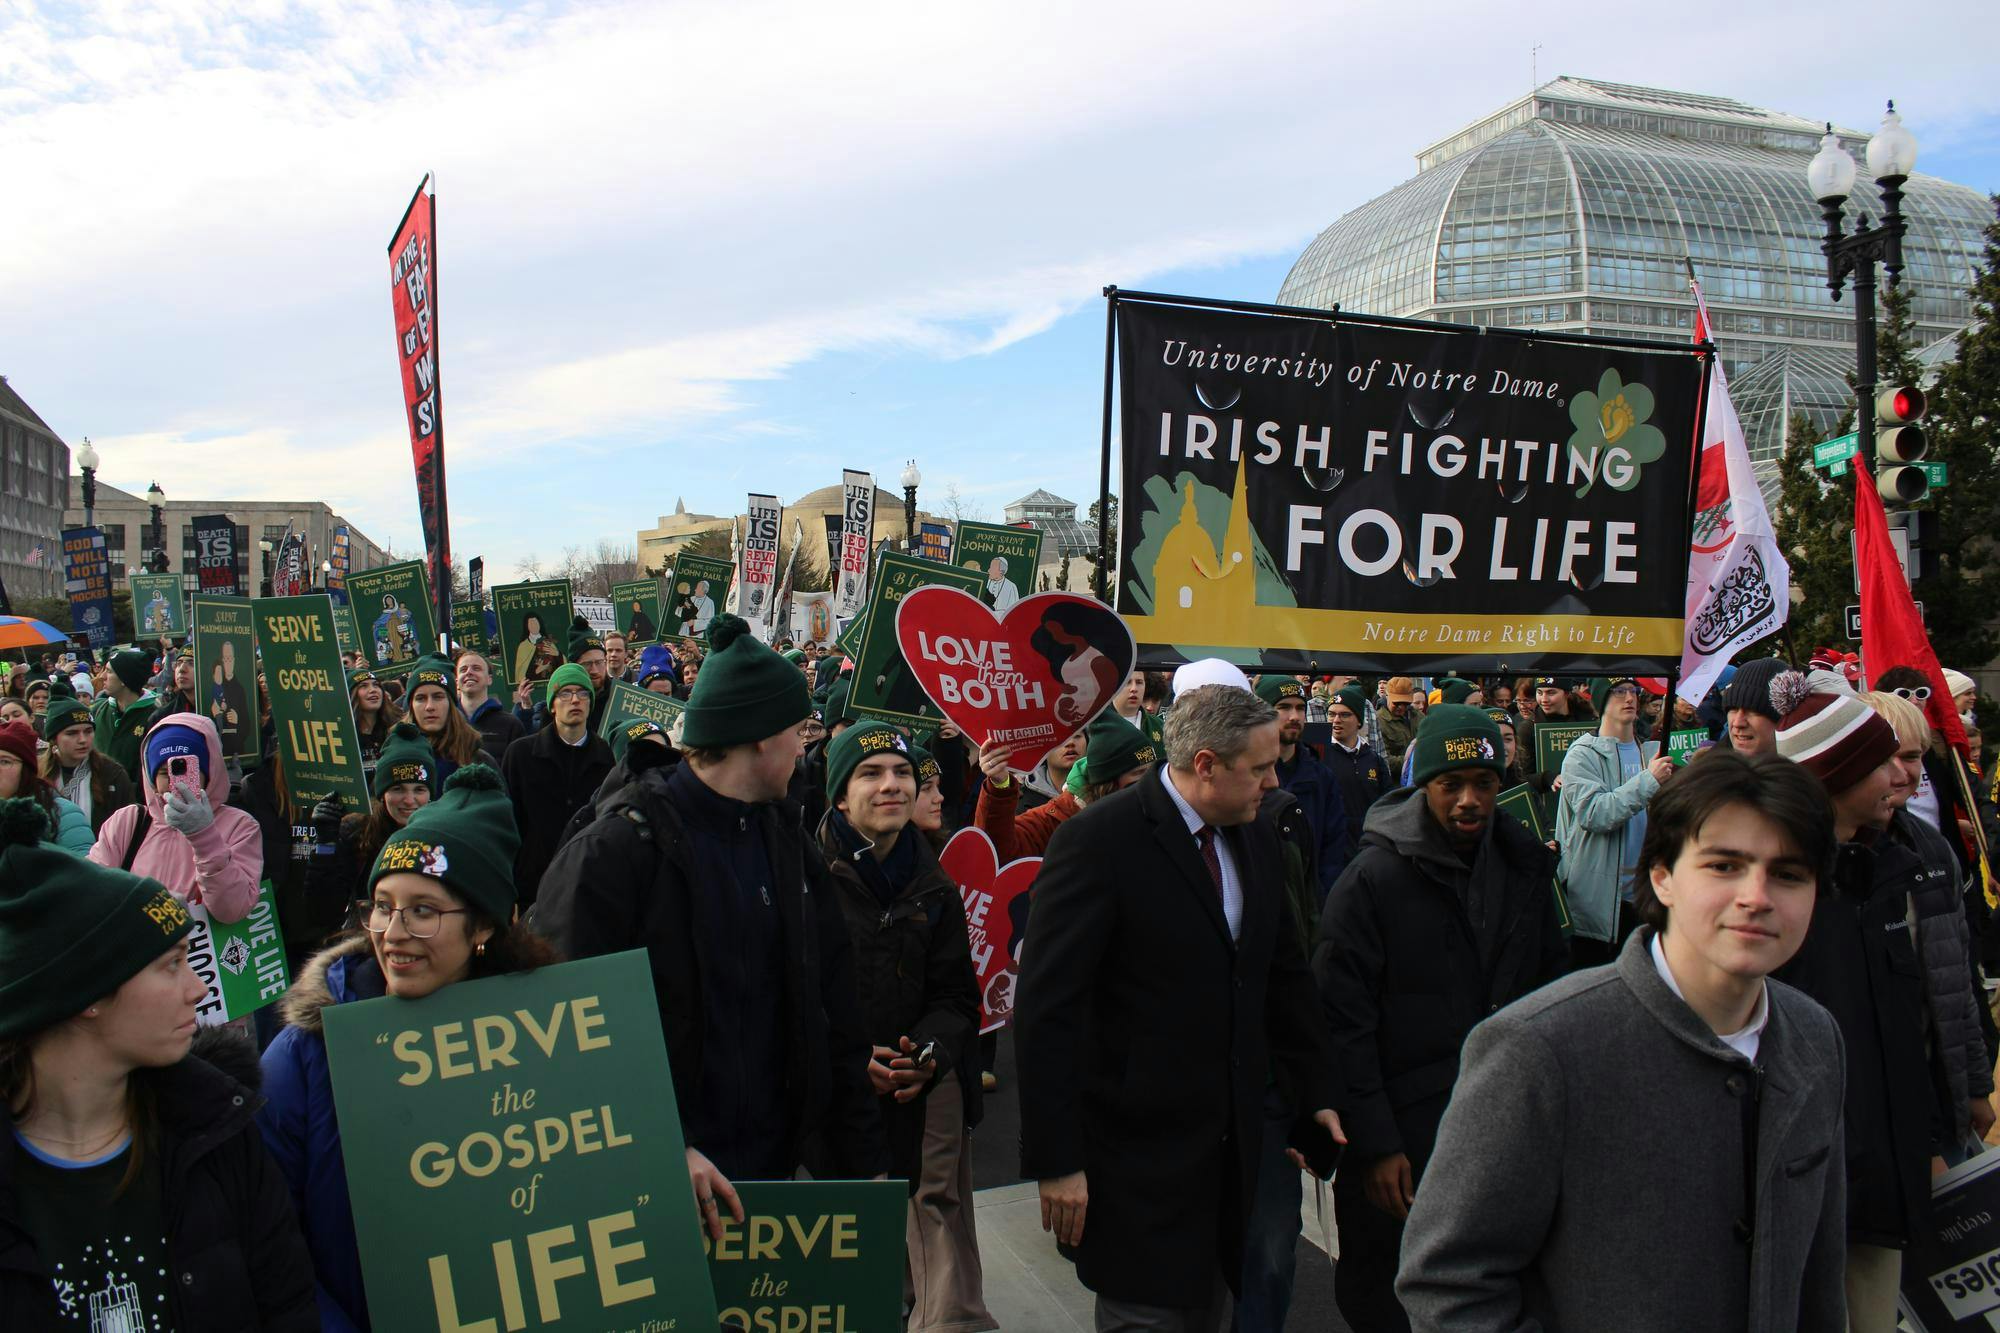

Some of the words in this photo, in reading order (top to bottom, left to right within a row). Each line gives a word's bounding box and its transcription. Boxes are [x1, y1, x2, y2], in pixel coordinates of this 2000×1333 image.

[1163, 339, 1334, 388] University
[1347, 358, 1381, 391] of
[1387, 362, 1477, 394] Notre
[1159, 411, 1331, 469] IRISH
[1364, 430, 1635, 488] FIGHTING
[750, 507, 778, 520] LIFE
[845, 498, 869, 523] IS
[197, 528, 231, 539] DEATH
[748, 519, 778, 541] IS
[64, 538, 92, 552] GOD
[746, 538, 776, 551] OUR
[922, 533, 941, 545] GOD
[1286, 503, 1464, 580] FOR
[1490, 515, 1638, 584] LIFE
[198, 537, 233, 557] IS
[961, 541, 994, 553] JOHN
[997, 545, 1025, 557] PAUL
[1028, 548, 1035, 557] II
[72, 551, 105, 564] WILL
[199, 556, 232, 568] NOT
[746, 550, 776, 562] REVO
[71, 564, 97, 577] NOT
[746, 560, 774, 573] LUT
[355, 577, 382, 589] Notre
[385, 571, 413, 583] Dame
[679, 567, 701, 577] JOHN
[703, 571, 721, 581] PAUL
[745, 571, 773, 585] ION!
[86, 577, 104, 588] BE
[363, 586, 380, 596] Our
[381, 581, 411, 593] Mother
[70, 589, 108, 603] MOCKED
[202, 586, 235, 595] HERE!
[502, 594, 522, 604] Saint
[512, 598, 566, 609] Lisieux
[200, 625, 234, 634] MAXIMILIAN
[1362, 621, 1429, 643] Notre
[1435, 624, 1493, 644] Dame
[1501, 623, 1560, 646] Right
[1568, 625, 1585, 645] to
[1592, 624, 1636, 646] Life
[295, 649, 307, 664] the
[918, 631, 1013, 671] LOVE
[960, 658, 1029, 686] them
[279, 669, 334, 691] GOSPEL
[938, 673, 1046, 710] BOTH
[304, 695, 313, 712] of
[624, 691, 681, 716] IMMACULATE
[621, 698, 672, 724] HEART
[1014, 725, 1053, 740] ACTION
[860, 734, 890, 747] Right
[873, 742, 892, 750] Life
[1445, 741, 1477, 753] Right
[1458, 750, 1478, 759] Life
[392, 766, 414, 776] Right
[383, 846, 419, 859] Right
[390, 856, 416, 869] Life
[254, 947, 287, 1000] LIFE
[491, 1084, 536, 1116] the
[410, 1105, 633, 1188] GOSPEL
[510, 1173, 544, 1214] of
[750, 1274, 788, 1298] the
